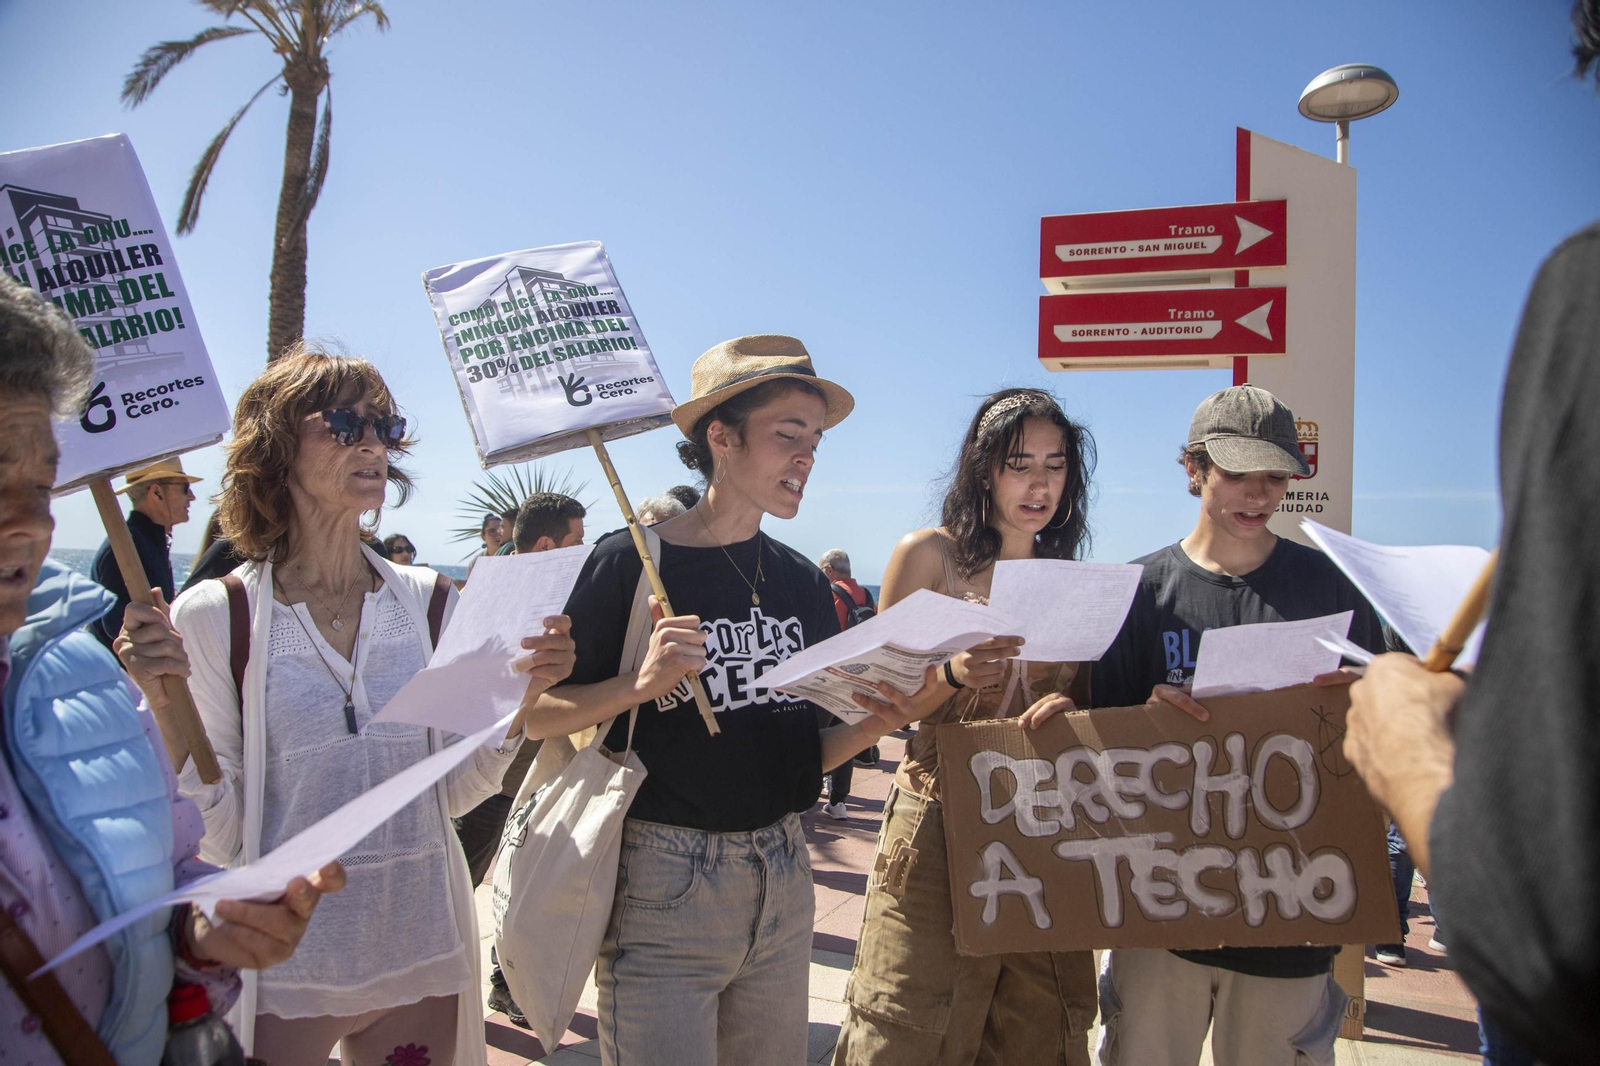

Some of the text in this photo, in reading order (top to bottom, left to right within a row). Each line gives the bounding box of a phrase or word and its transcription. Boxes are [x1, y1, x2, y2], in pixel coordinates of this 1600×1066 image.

[47, 231, 77, 255] LA
[1169, 225, 1216, 236] Tramo
[1069, 246, 1127, 257] SORRENTO
[1138, 244, 1160, 253] SAN
[1164, 241, 1207, 251] MIGUEL
[37, 243, 163, 293] ALQUILER
[117, 272, 175, 306] DEL
[449, 306, 495, 326] COMO
[501, 295, 539, 313] DICE
[543, 290, 563, 304] LA
[536, 299, 622, 324] ALQUILER
[1168, 308, 1215, 320] Tramo
[460, 317, 631, 365] POR ENCIMA DEL
[1071, 328, 1130, 338] SORRENTO
[1140, 325, 1203, 336] AUDITORIO
[466, 336, 639, 384] 30% DEL SALARIO!
[121, 376, 204, 406] Recortes
[595, 376, 655, 392] Recortes
[599, 388, 638, 400] Cero.
[125, 397, 180, 419] Cero.
[1281, 491, 1330, 501] MERIA
[1162, 626, 1213, 671] BL
[968, 732, 1322, 838] DERECHO
[968, 832, 1357, 930] A TECHO
